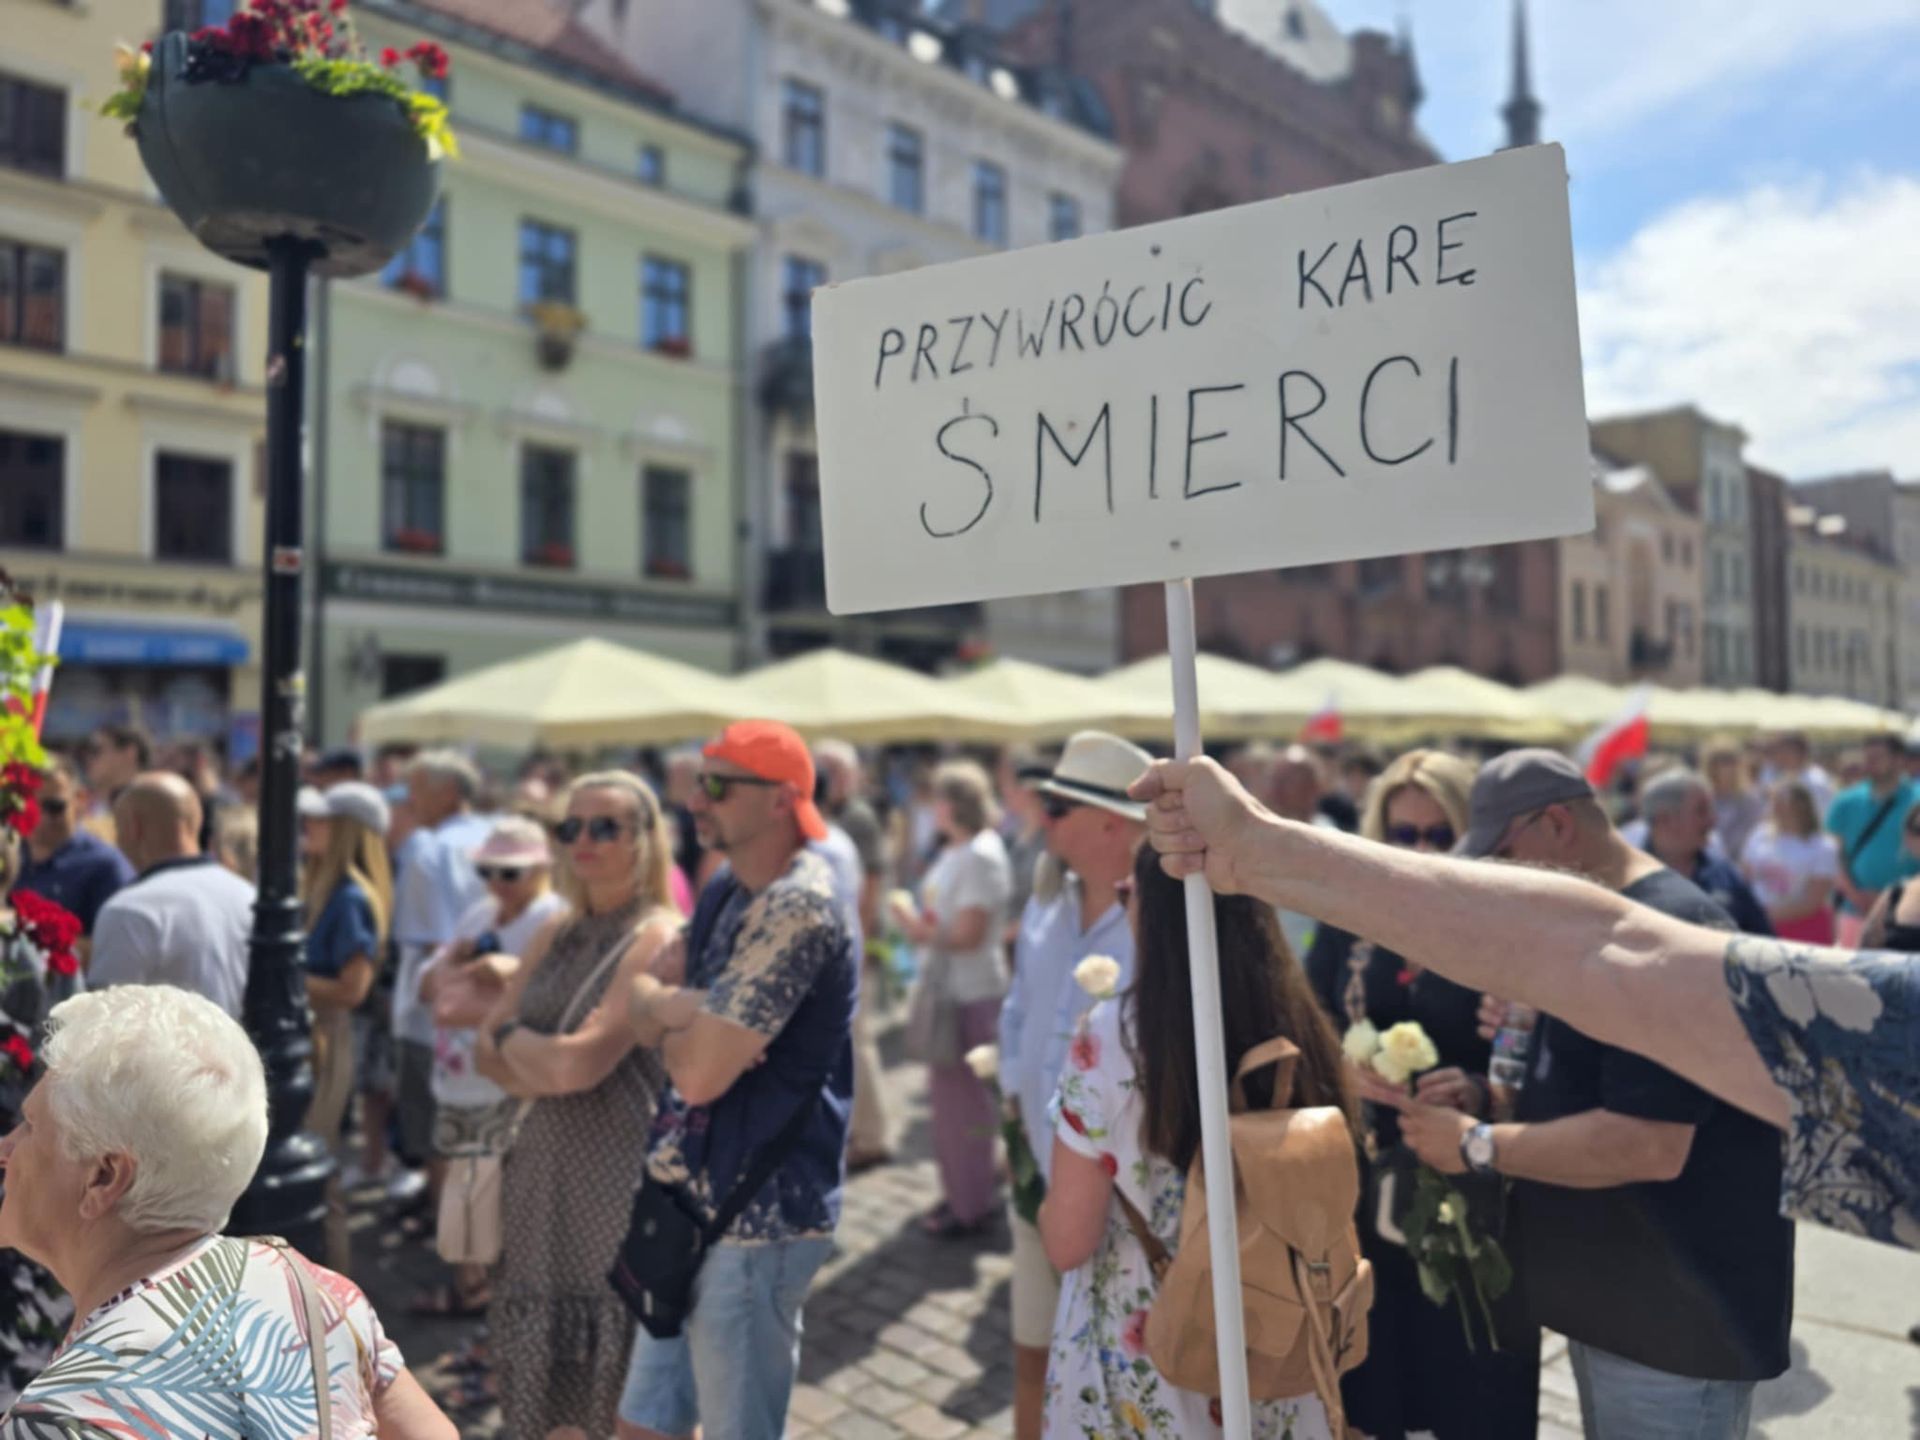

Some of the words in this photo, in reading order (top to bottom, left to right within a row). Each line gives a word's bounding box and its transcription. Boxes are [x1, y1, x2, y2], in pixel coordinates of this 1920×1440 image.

[874, 265, 1213, 390] PRZYWRÓCIĆ
[1297, 211, 1479, 309] KARĘ
[919, 355, 1460, 538] ŚMIERCI
